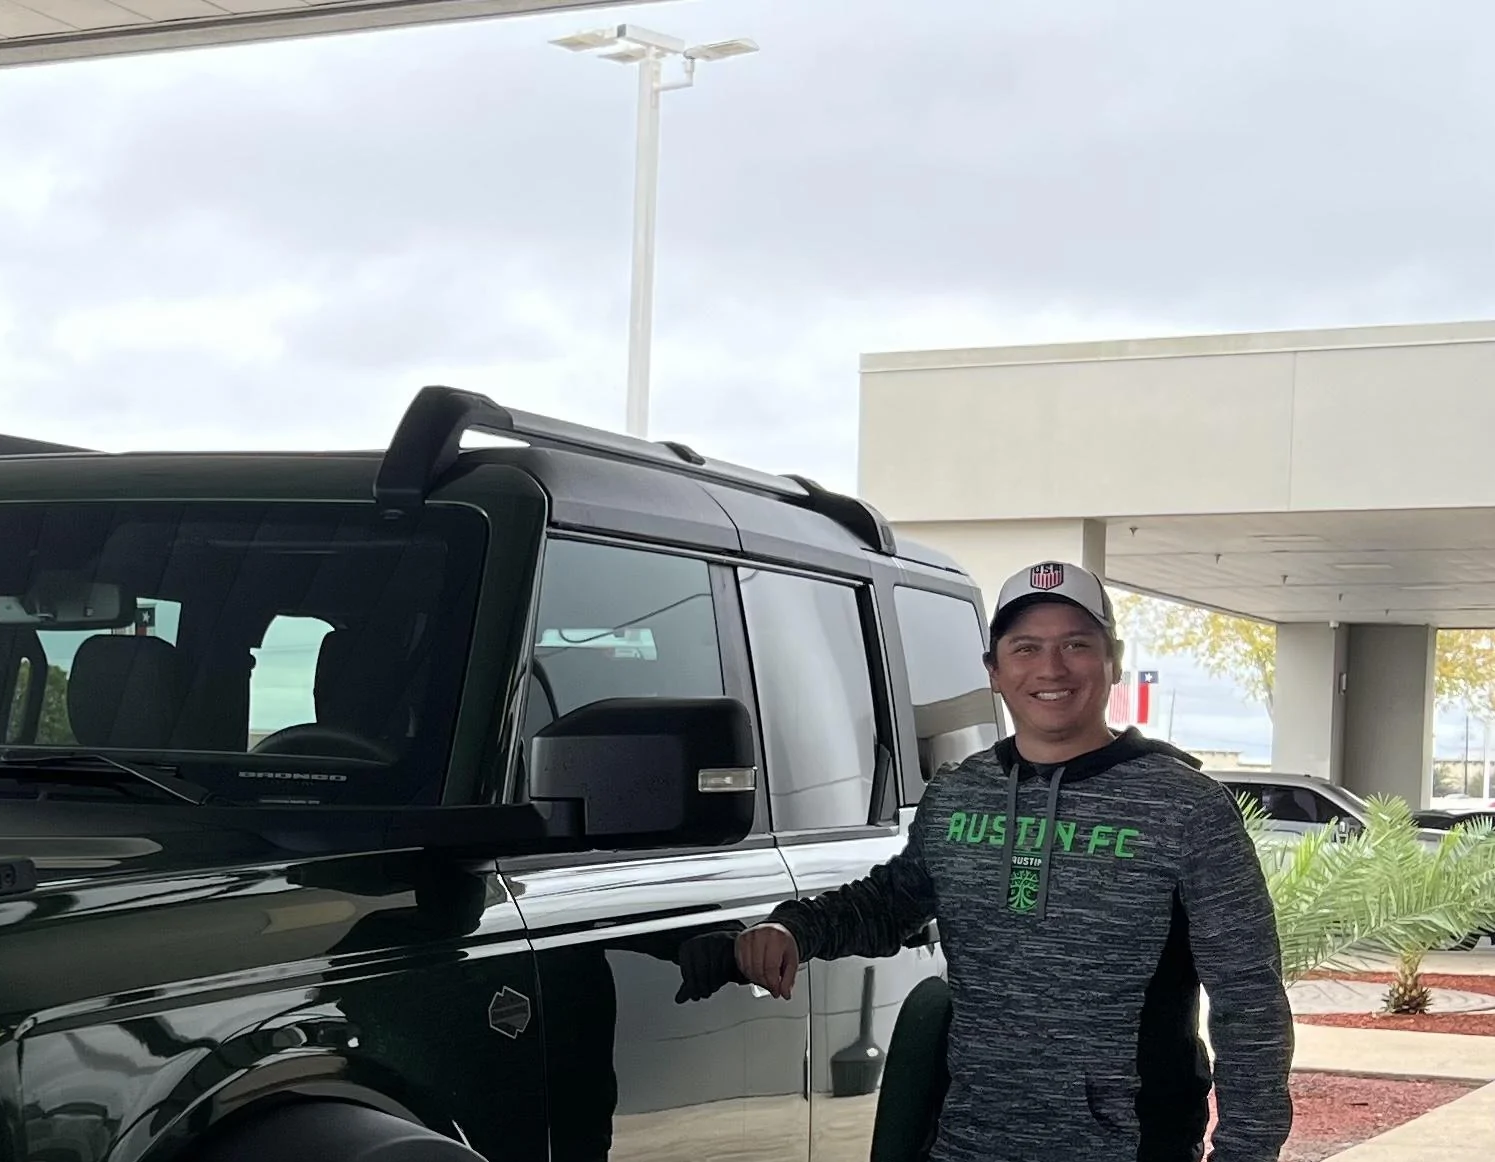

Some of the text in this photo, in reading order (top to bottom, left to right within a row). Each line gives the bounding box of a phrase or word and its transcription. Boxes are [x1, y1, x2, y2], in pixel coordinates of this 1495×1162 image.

[238, 771, 347, 782] BRONCO
[946, 812, 1140, 859] AUSTIN FC
